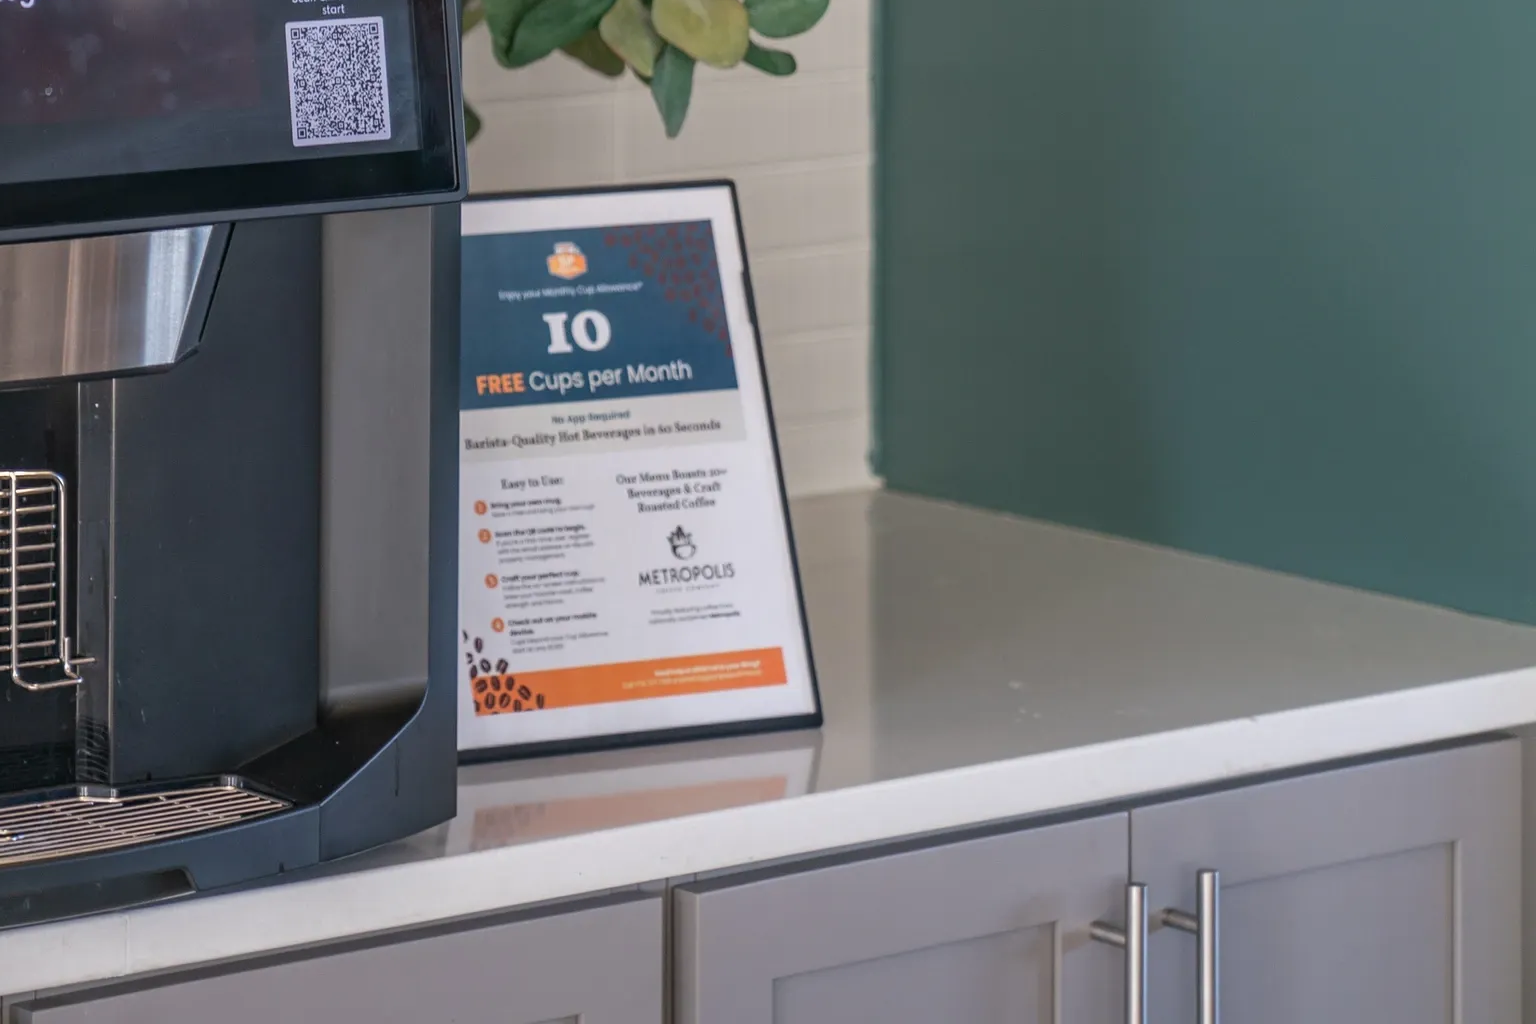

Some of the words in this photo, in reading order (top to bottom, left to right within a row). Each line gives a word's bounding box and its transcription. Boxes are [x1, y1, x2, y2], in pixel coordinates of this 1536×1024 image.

[322, 4, 345, 15] start
[542, 309, 612, 354] 10
[476, 373, 526, 395] FREE
[529, 370, 585, 395] Cups
[588, 369, 622, 392] per
[626, 359, 693, 384] Month
[566, 414, 586, 425] App
[560, 430, 580, 442] Hot
[582, 425, 641, 441] Beverages
[643, 426, 656, 436] in
[674, 419, 721, 433] Seconds
[500, 478, 525, 491] Easy
[528, 477, 539, 487] to
[616, 474, 636, 485] Our
[639, 471, 669, 483] Menu
[627, 486, 681, 499] Beverages
[693, 481, 721, 493] Craft
[637, 501, 679, 513] Roasted
[682, 497, 716, 509] Coffee
[639, 562, 735, 587] METROPOLIS
